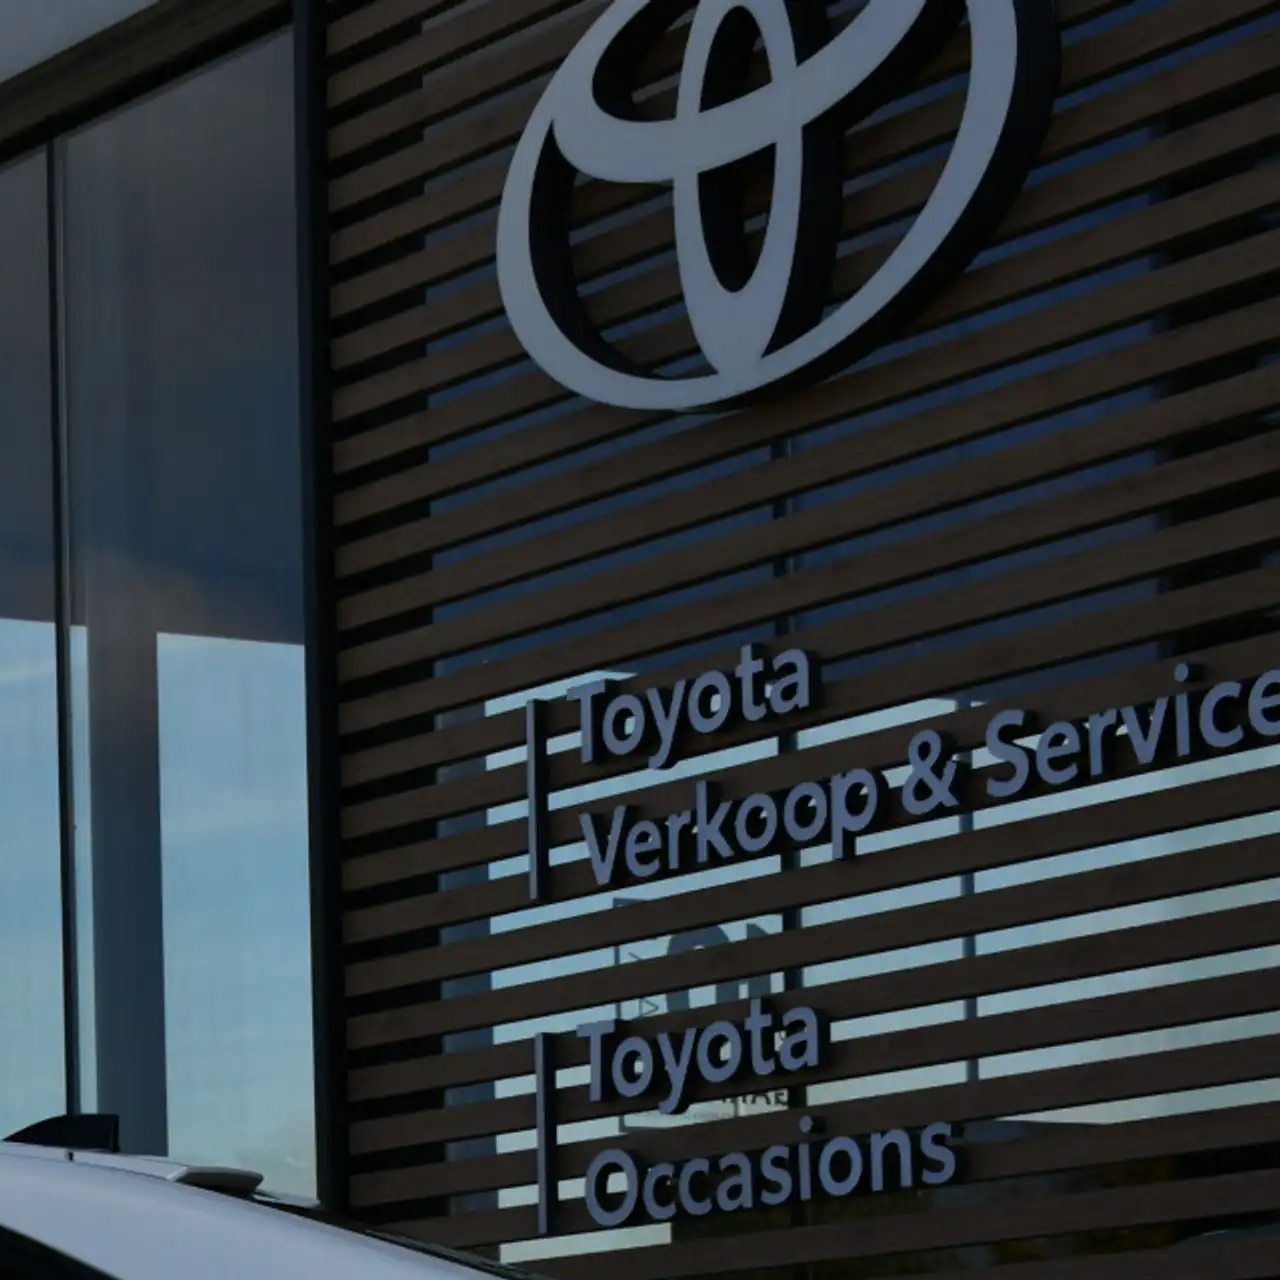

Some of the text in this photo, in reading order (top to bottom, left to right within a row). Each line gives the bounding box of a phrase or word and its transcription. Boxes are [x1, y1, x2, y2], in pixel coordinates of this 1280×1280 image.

[566, 643, 810, 770] Toyota
[579, 662, 1280, 885] Verkoop & Service
[576, 997, 819, 1114] Toyota
[585, 1115, 956, 1227] Occasions
